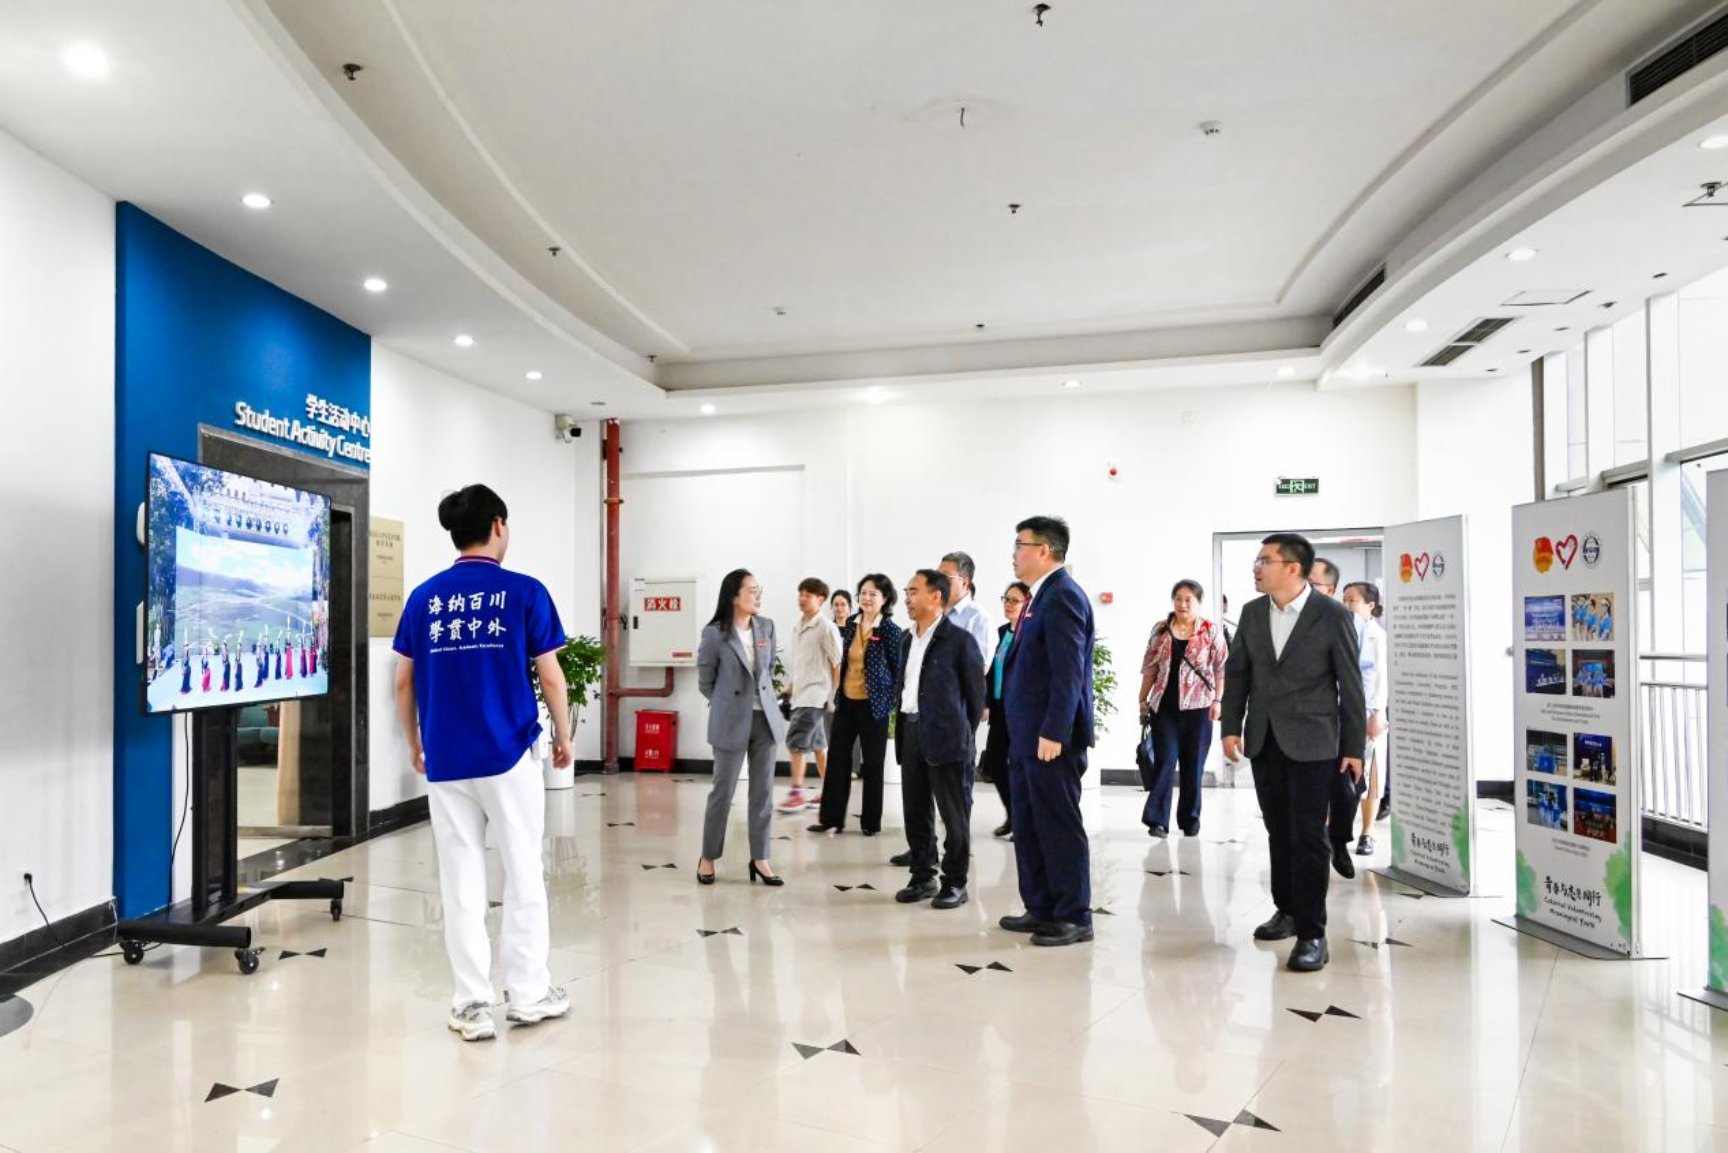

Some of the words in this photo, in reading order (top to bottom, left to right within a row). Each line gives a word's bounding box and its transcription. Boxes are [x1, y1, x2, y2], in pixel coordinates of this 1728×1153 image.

[234, 401, 290, 439] Student
[289, 420, 337, 457] Activity
[336, 434, 371, 463] Centre
[305, 393, 371, 437] 学生活动中心
